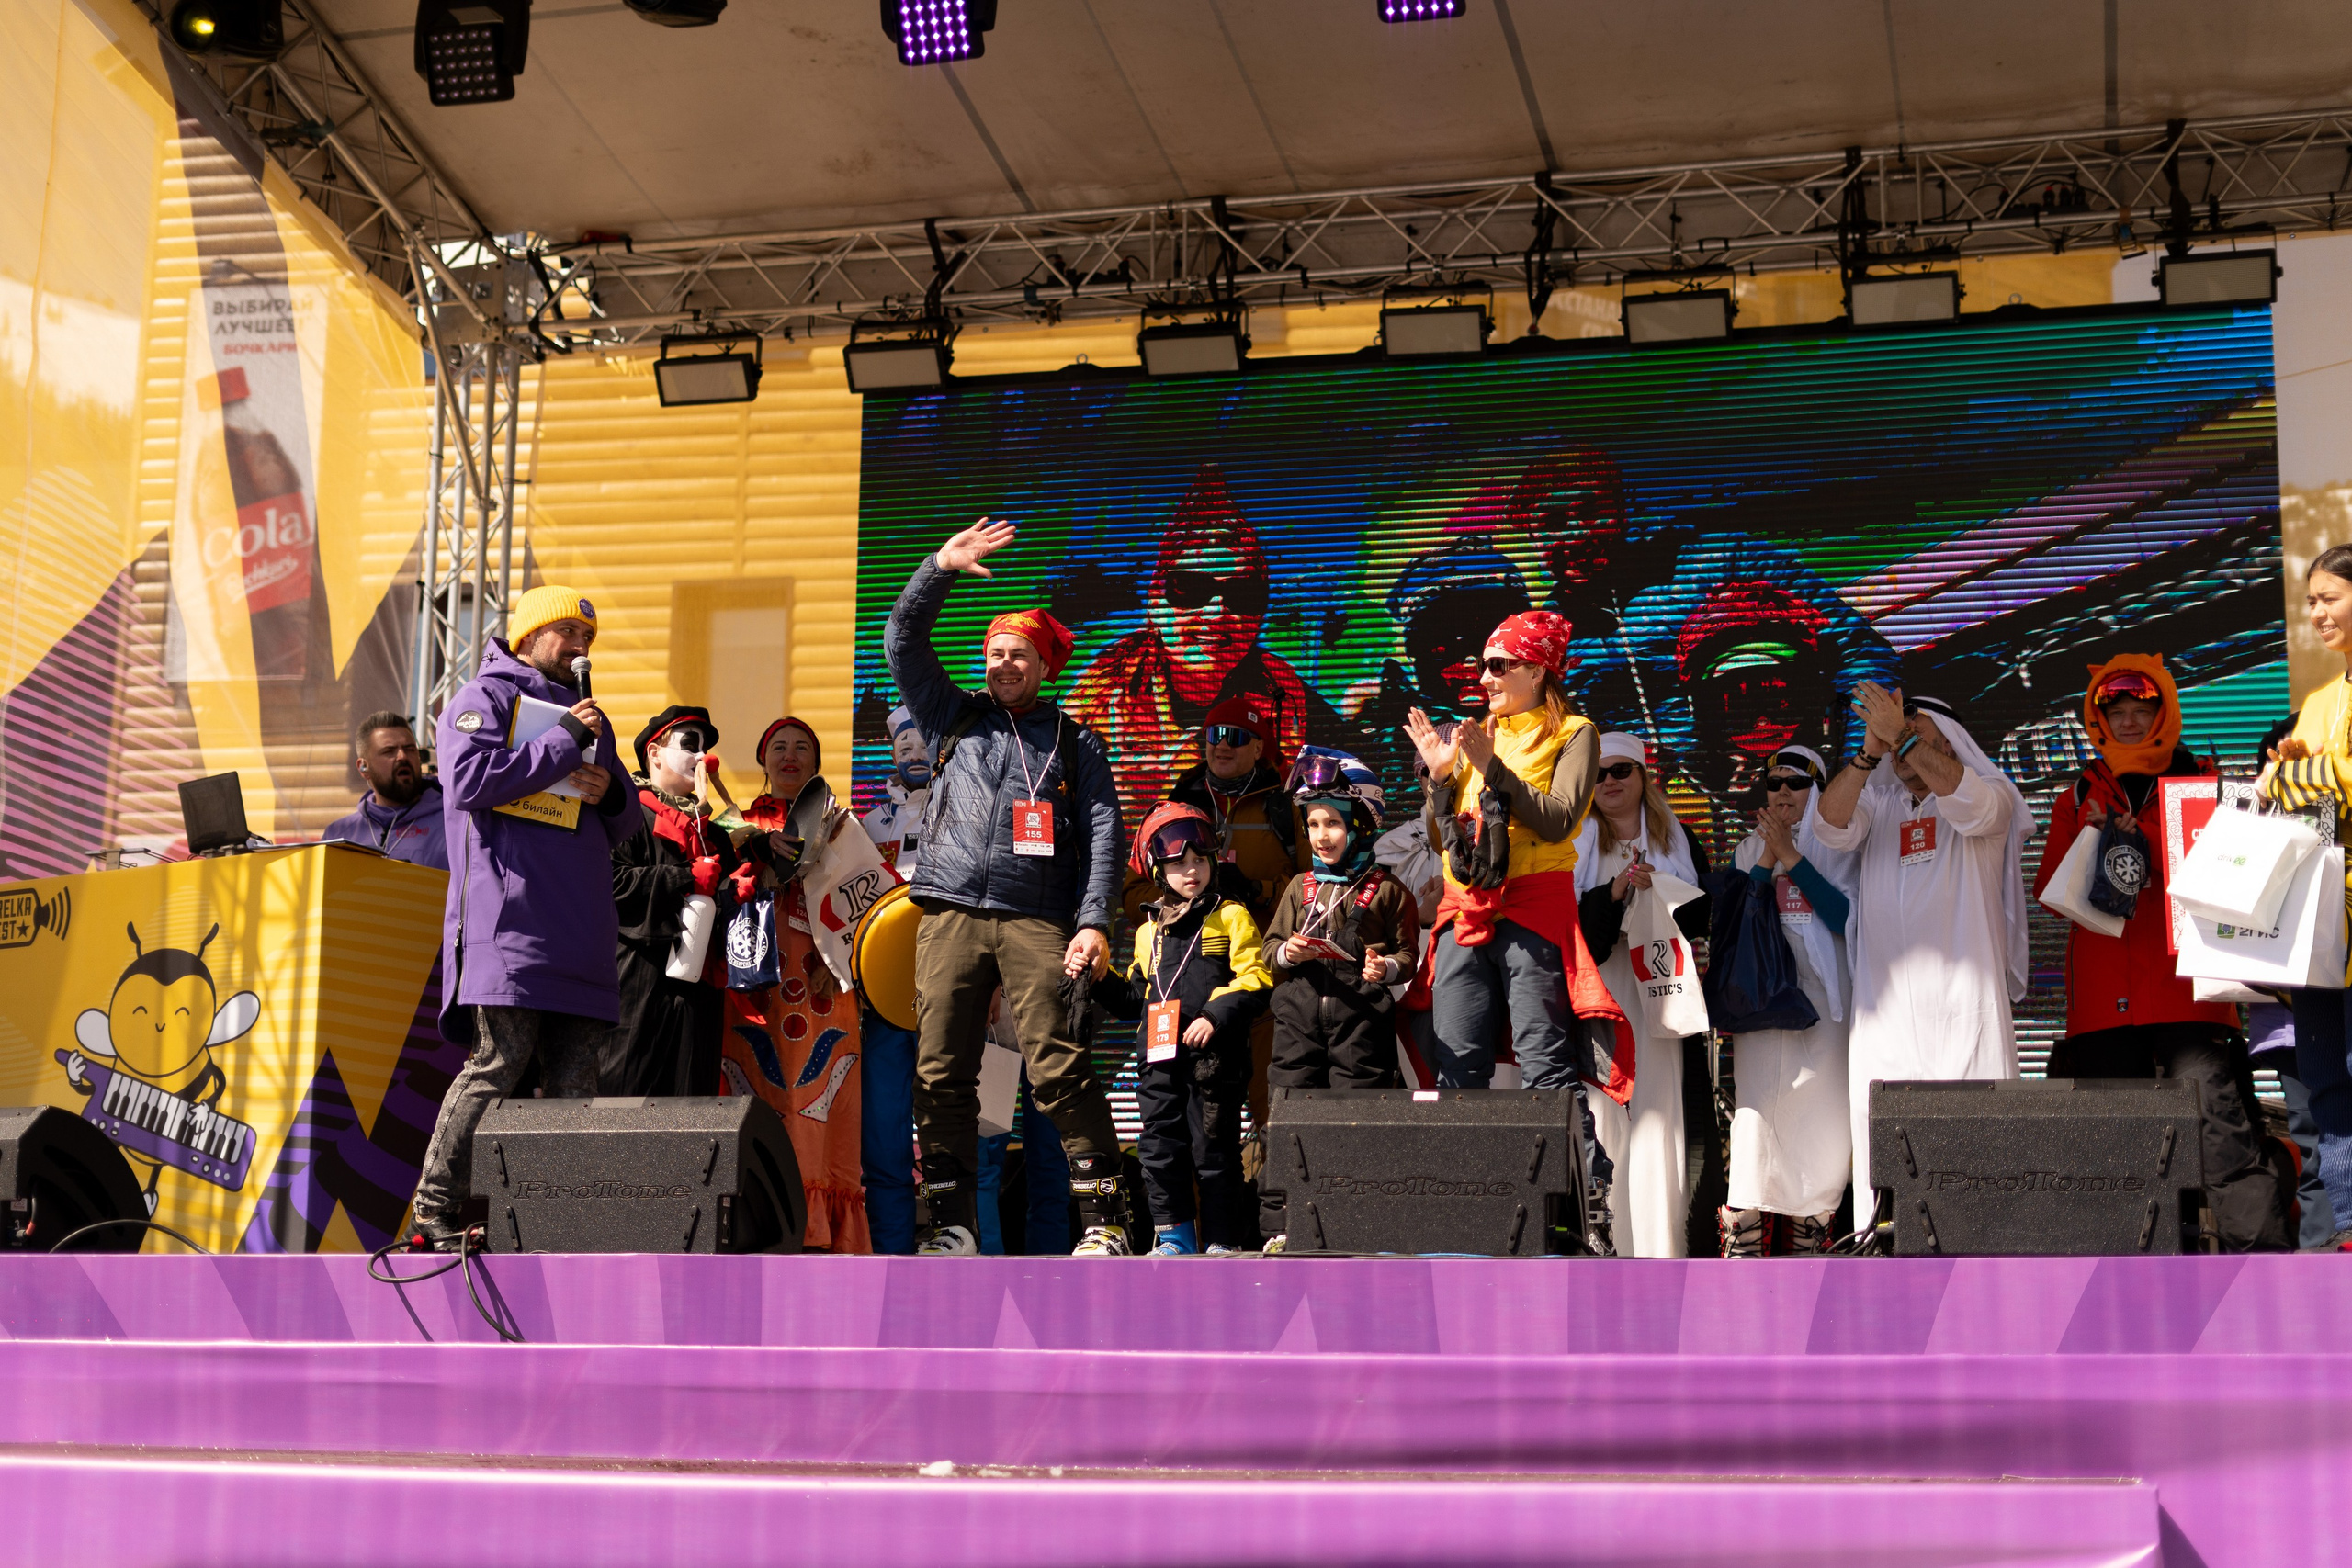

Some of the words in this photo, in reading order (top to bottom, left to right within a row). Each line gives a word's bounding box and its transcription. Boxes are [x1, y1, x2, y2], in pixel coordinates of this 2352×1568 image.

[203, 508, 305, 568] Cola
[522, 800, 563, 818] билайн
[1024, 830, 1043, 839] 155
[1910, 841, 1926, 850] 120
[797, 908, 808, 918] 124
[1156, 1033, 1170, 1043] 179
[514, 1179, 693, 1200] ProTone
[1316, 1175, 1516, 1197] ProTone
[1925, 1170, 2146, 1192] ProTone
